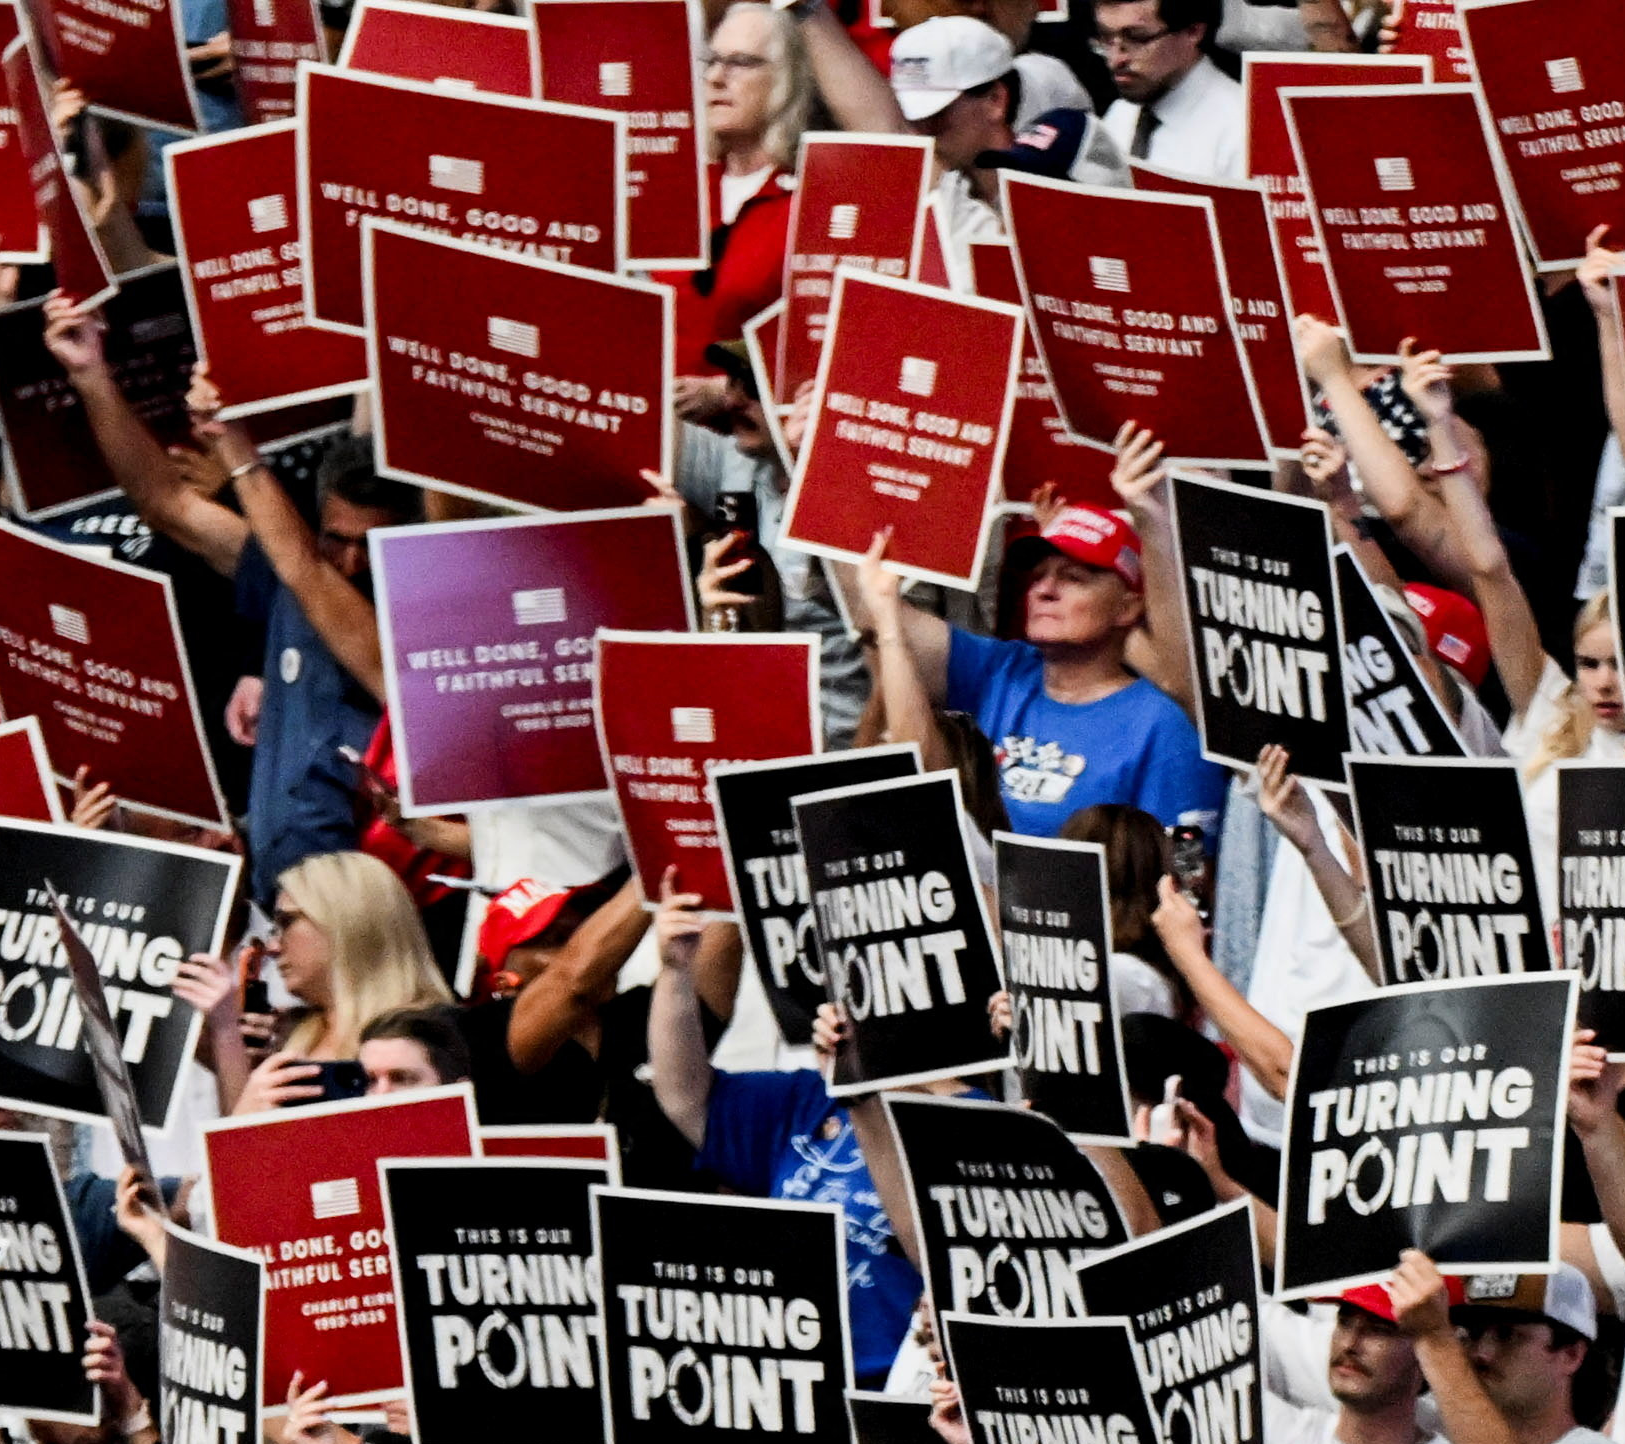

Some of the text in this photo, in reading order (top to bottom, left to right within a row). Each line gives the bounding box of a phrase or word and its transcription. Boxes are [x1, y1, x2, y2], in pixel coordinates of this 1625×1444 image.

[1354, 1044, 1487, 1076] THIS IS OUR
[1309, 1067, 1533, 1142] TURNING
